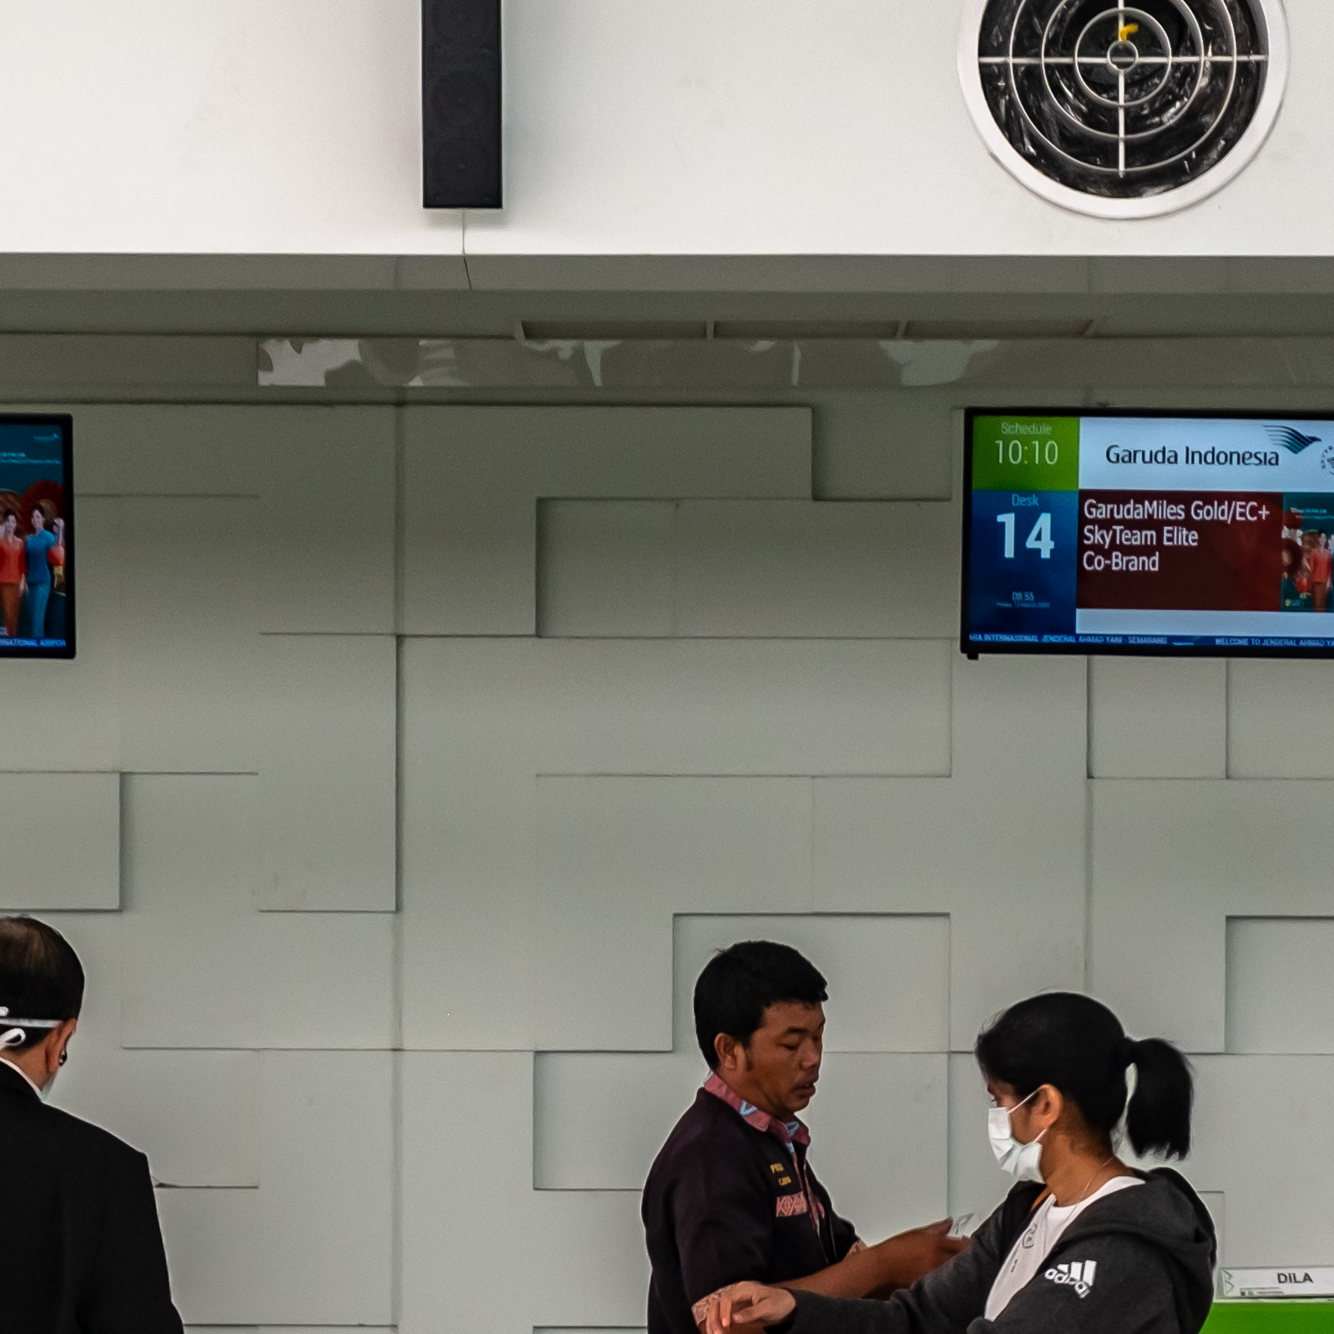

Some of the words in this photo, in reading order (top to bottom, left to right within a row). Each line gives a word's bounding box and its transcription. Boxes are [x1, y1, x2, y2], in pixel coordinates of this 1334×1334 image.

[1001, 422, 1052, 435] Schedule
[995, 439, 1059, 466] 10:10
[1105, 444, 1178, 466] Garuda
[1185, 445, 1280, 467] Indonesia
[1011, 494, 1039, 507] Desk
[1084, 499, 1185, 522] GarudaMiles
[1190, 500, 1271, 525] Gold/EC+
[996, 512, 1055, 560] 14
[1083, 525, 1156, 549] SkyTeam
[1163, 526, 1198, 547] Elite
[1083, 551, 1159, 572] Co-Brand
[1277, 1273, 1313, 1284] DILA
